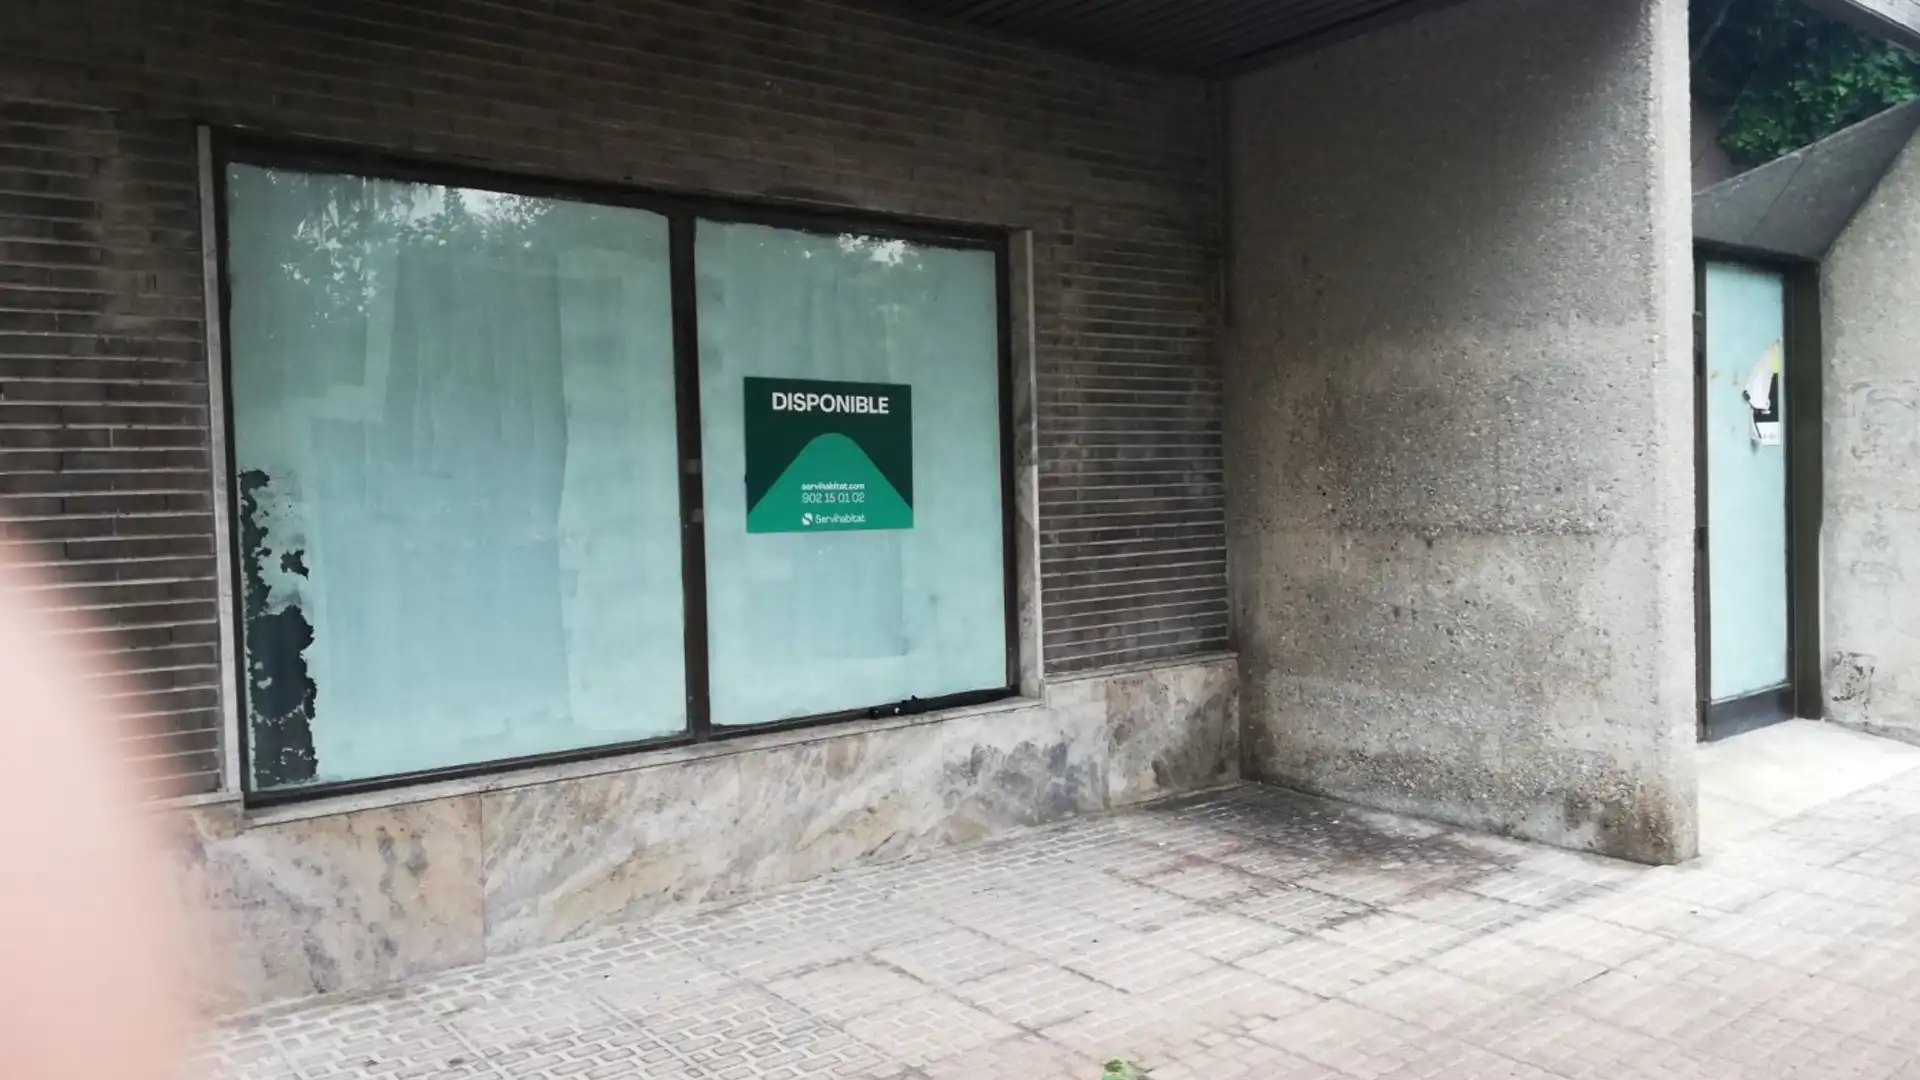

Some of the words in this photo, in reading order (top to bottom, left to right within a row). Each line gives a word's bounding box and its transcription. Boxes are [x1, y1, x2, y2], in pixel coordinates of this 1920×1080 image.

[772, 392, 889, 414] DISPONIBLE
[801, 482, 865, 490] servihabitat.com
[802, 492, 822, 503] 902
[825, 492, 835, 502] 15
[838, 492, 850, 503] 01
[852, 492, 865, 502] 02
[815, 513, 866, 524] Servihabitat
